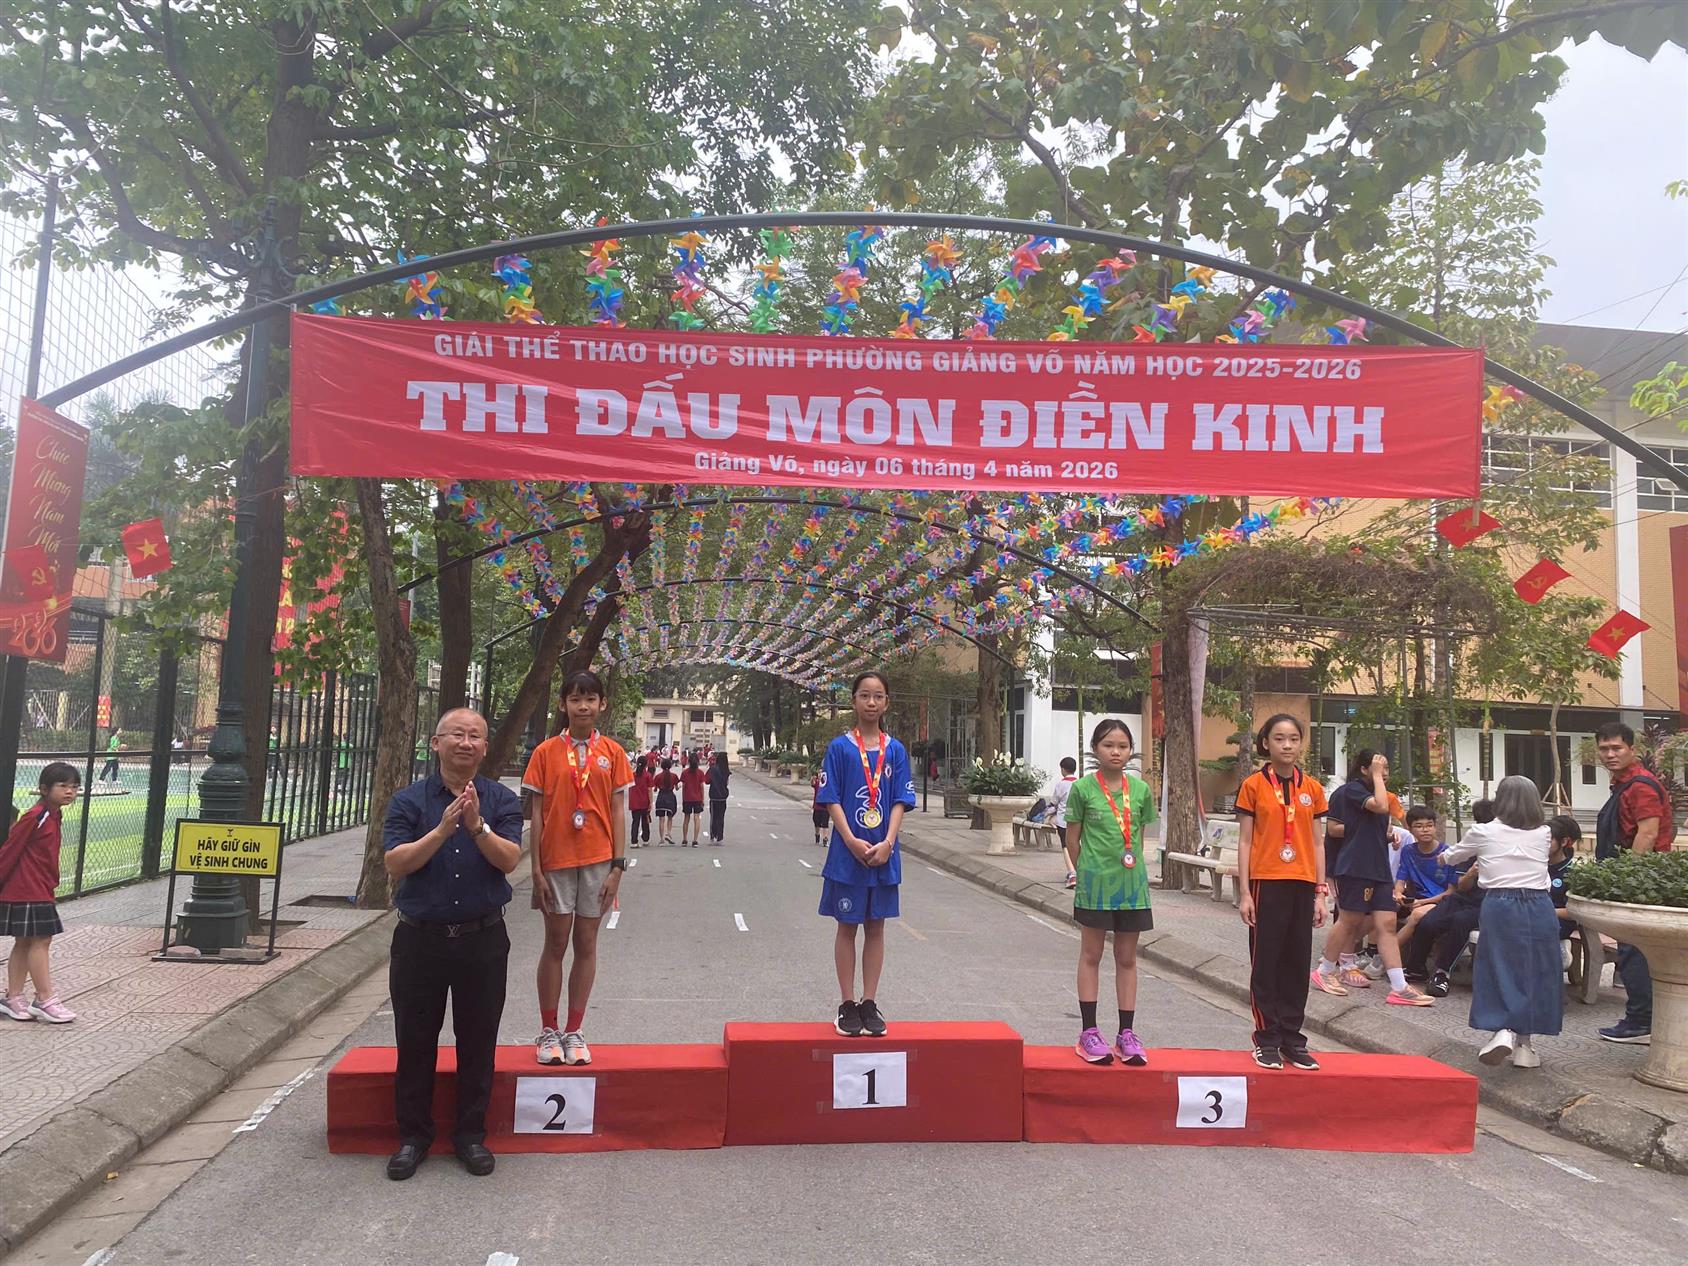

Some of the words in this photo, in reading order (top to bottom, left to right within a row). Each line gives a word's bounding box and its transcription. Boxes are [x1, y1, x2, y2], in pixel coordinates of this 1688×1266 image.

[434, 331, 493, 357] GIẢI
[503, 331, 560, 359] THỂ
[570, 340, 647, 363] THAO
[658, 343, 718, 369] HỌC
[728, 345, 796, 368] SINH
[806, 345, 923, 371] PHƯỜNG
[932, 347, 1017, 373] GIẢNG
[1026, 349, 1064, 374] VÕ
[1073, 350, 1136, 375] NĂM
[1146, 355, 1204, 381] HỌC
[1212, 357, 1363, 380] 2025-2026
[406, 380, 550, 434] THI
[575, 372, 741, 440] ĐẤU
[765, 386, 957, 447] MÔN
[979, 380, 1169, 450] ĐIỀN
[1191, 403, 1386, 454] KINH
[694, 451, 761, 475] Giảng
[768, 454, 805, 475] Võ,
[812, 456, 868, 477] ngày
[874, 457, 904, 476] 06
[911, 457, 976, 481] tháng
[983, 460, 998, 477] 4
[1005, 460, 1053, 478] năm
[1060, 461, 1119, 479] 2026
[190, 852, 202, 869] VỆ
[204, 855, 229, 868] SINH
[231, 857, 268, 869] CHUNG
[197, 836, 219, 851] HÃY
[221, 838, 240, 852] GIỮ
[242, 838, 260, 853] GÌN
[862, 1068, 880, 1105] 1
[542, 1093, 567, 1131] 2
[1201, 1090, 1223, 1124] 3
